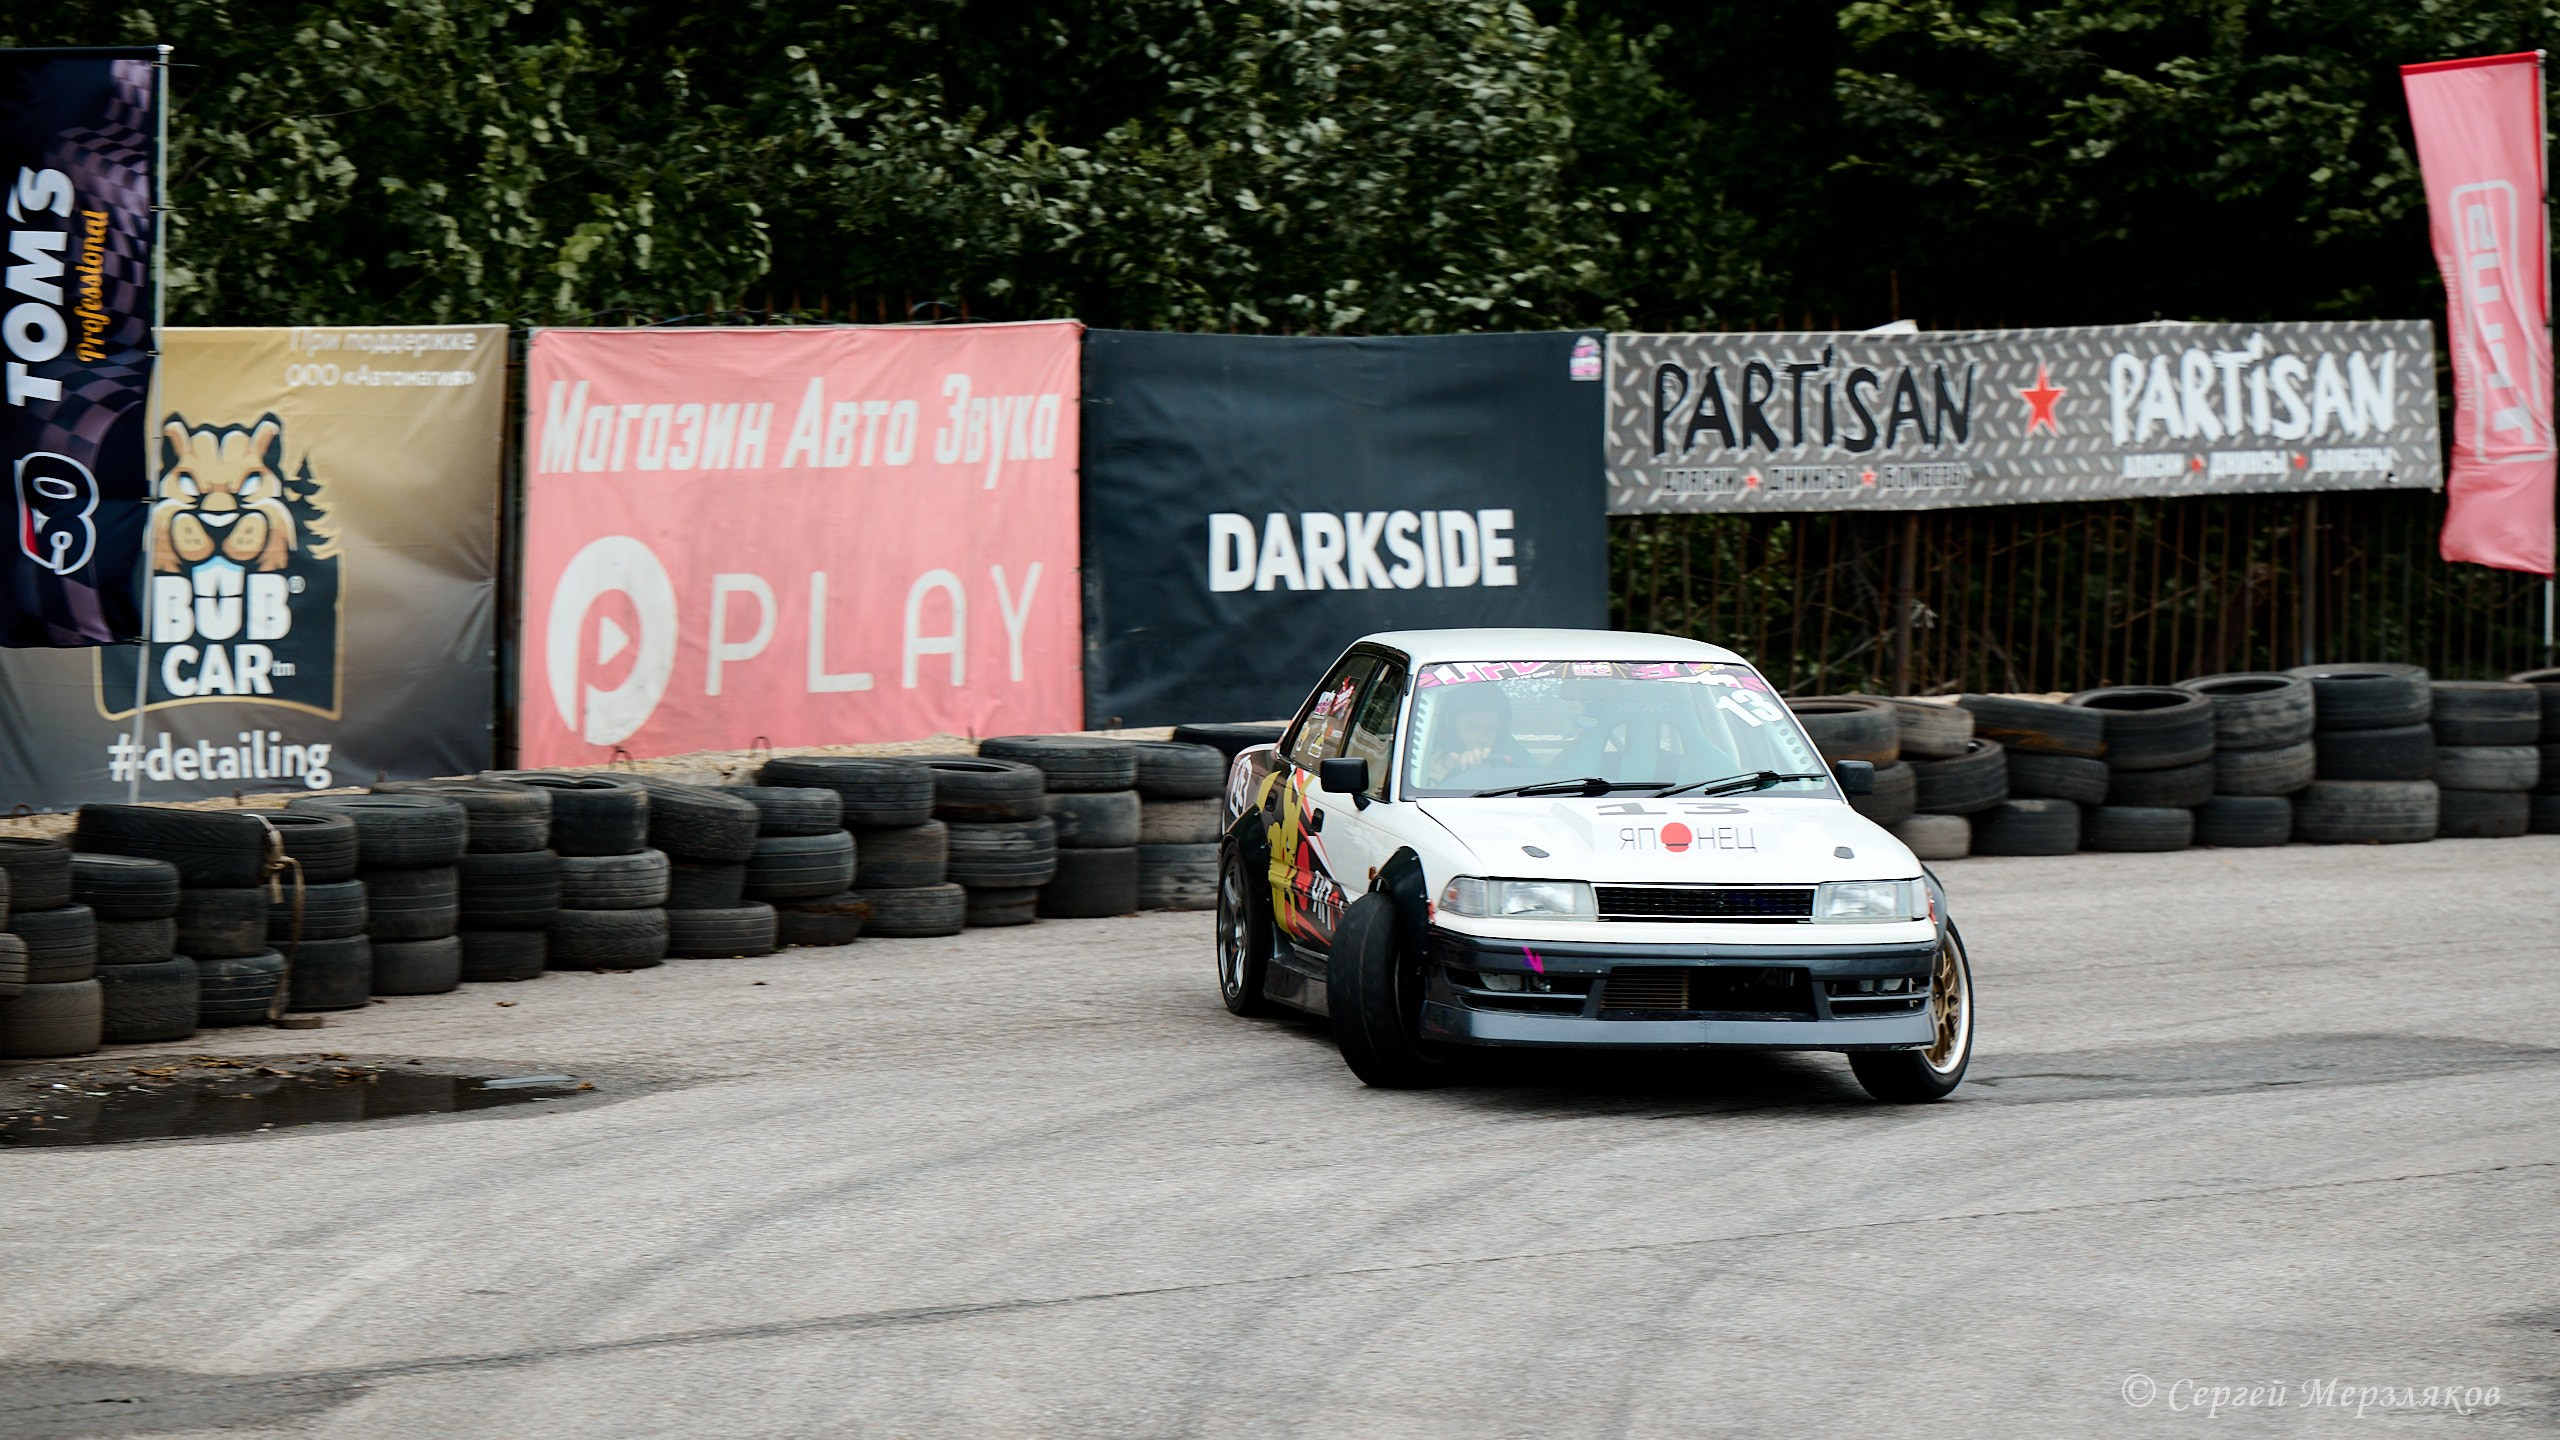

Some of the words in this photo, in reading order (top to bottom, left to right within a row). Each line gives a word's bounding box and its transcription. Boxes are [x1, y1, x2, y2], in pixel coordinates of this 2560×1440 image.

[75, 210, 111, 362] Professional
[285, 363, 340, 386] ООО
[538, 379, 774, 474] Магазин
[781, 376, 919, 469] Авто
[933, 373, 1061, 490] Звука
[1208, 508, 1518, 592] DARKSIDE
[706, 562, 1044, 696] PLAY
[1715, 689, 1784, 728] 13
[107, 730, 333, 790] #detailing
[1596, 802, 1750, 816] 13
